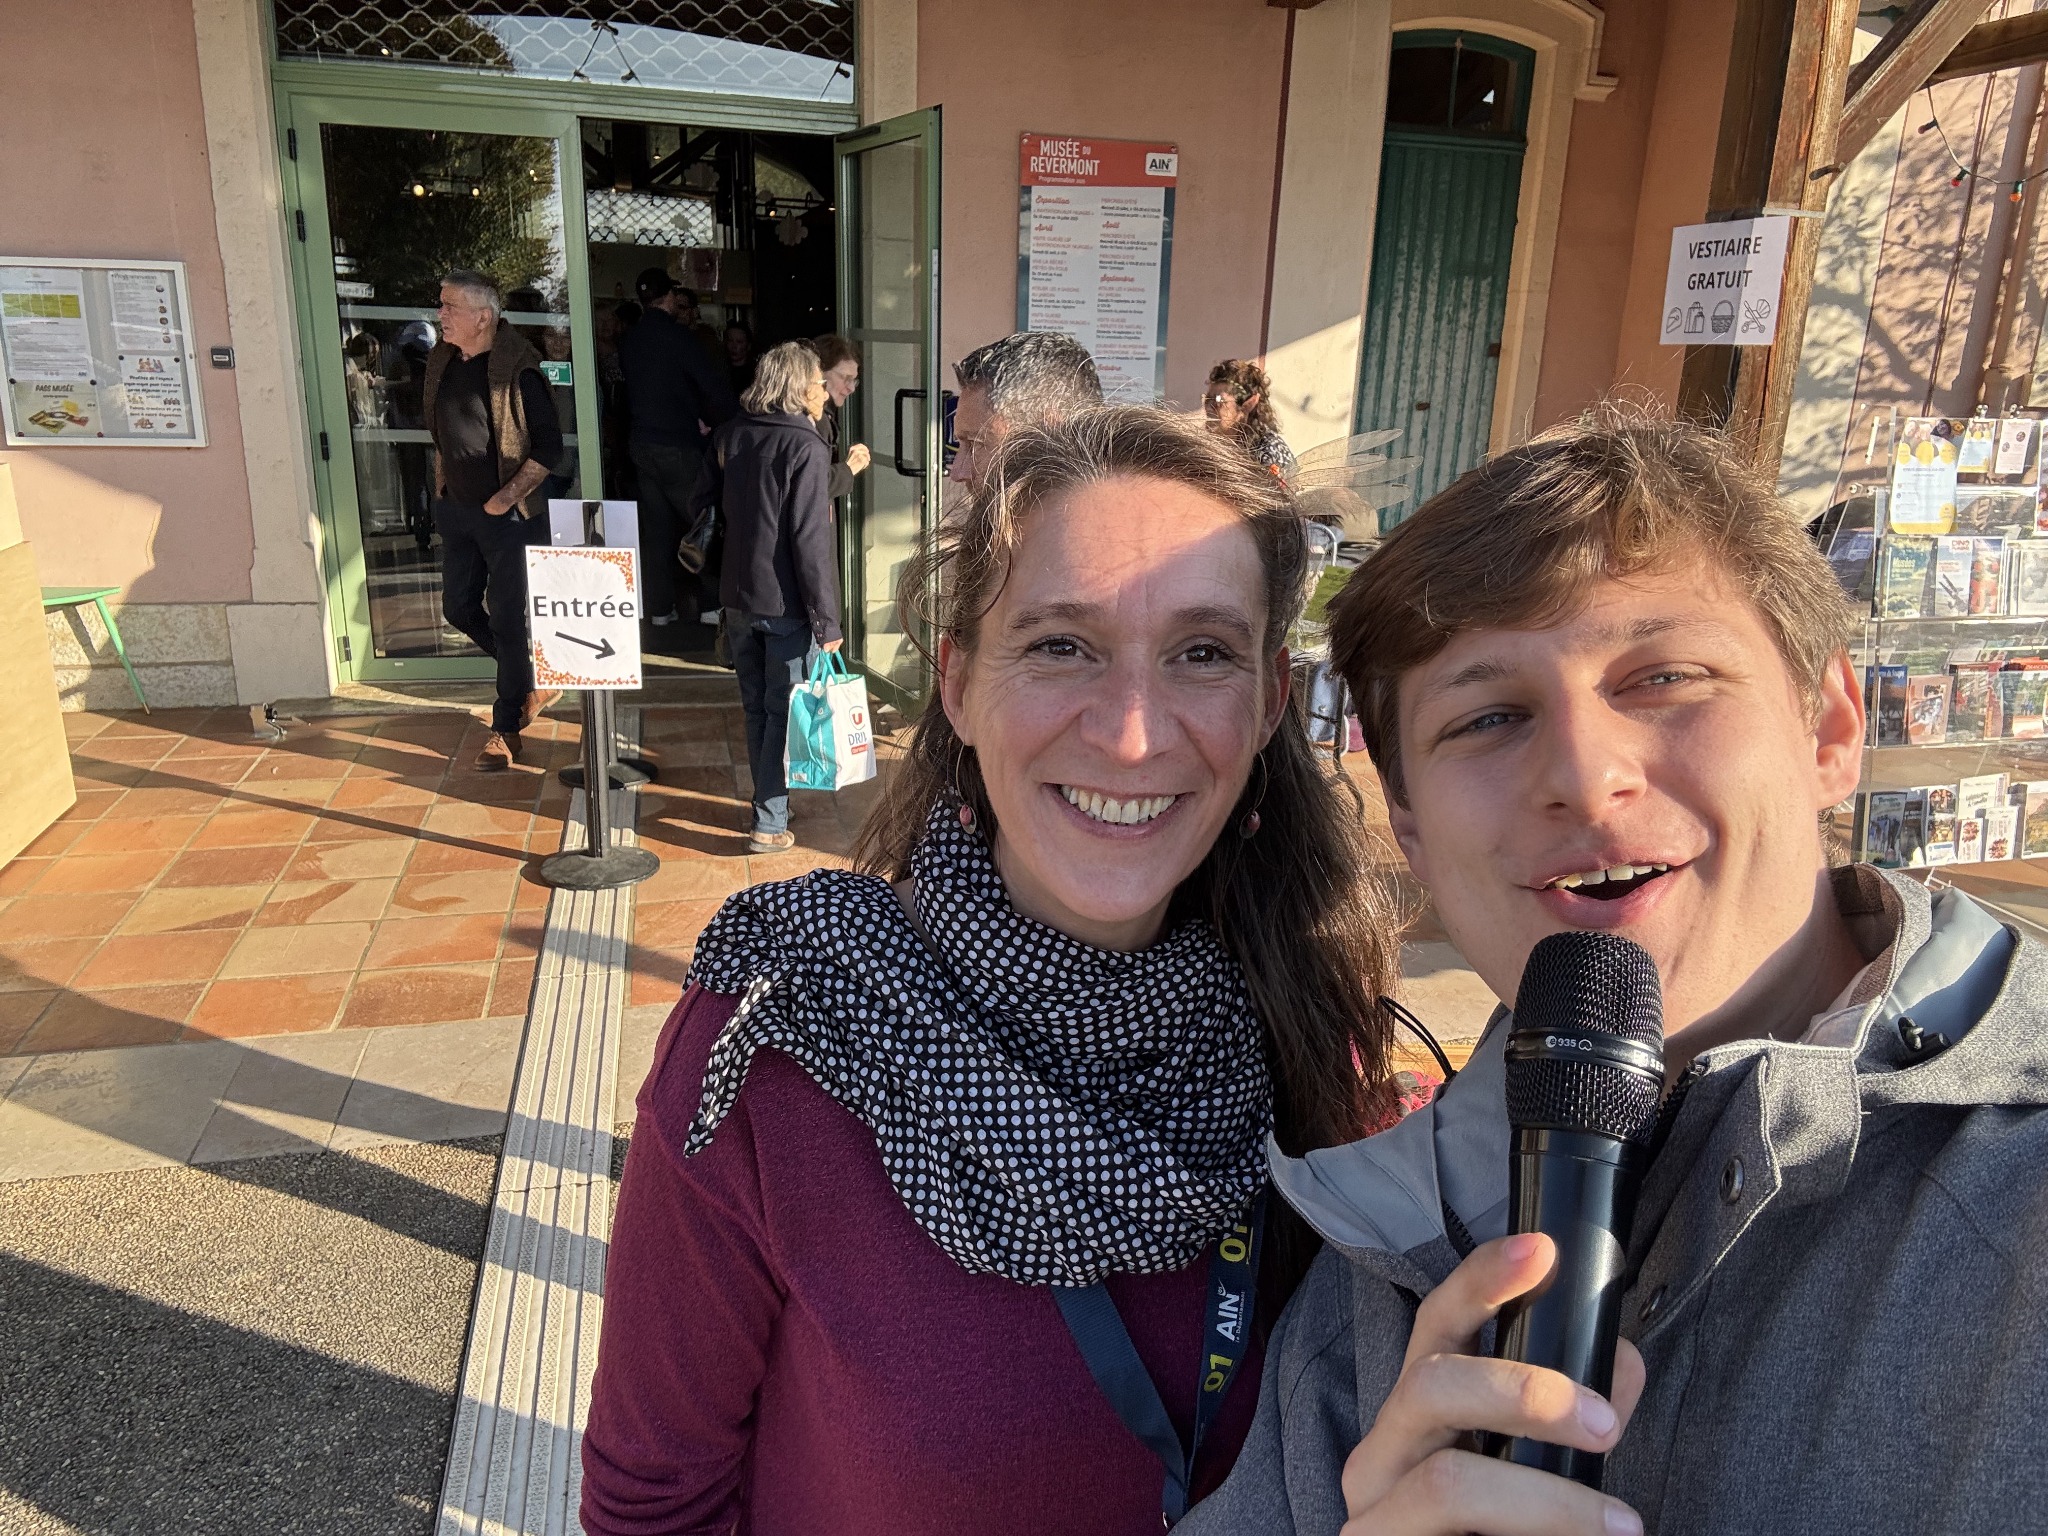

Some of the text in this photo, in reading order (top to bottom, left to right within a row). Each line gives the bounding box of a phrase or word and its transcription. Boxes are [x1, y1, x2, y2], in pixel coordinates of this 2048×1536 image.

[1040, 138, 1080, 158] MUSÉE
[1030, 156, 1100, 176] REVERMONT
[1149, 158, 1170, 170] AIN
[1689, 236, 1762, 259] VESTIAIRE
[1688, 270, 1752, 290] GRATUIT
[52, 384, 75, 392] MUSÉE
[533, 594, 635, 618] Entrée
[852, 713, 863, 725] U
[1557, 1038, 1577, 1047] 935
[1216, 1293, 1240, 1342] AIN
[1204, 1354, 1233, 1393] 01
